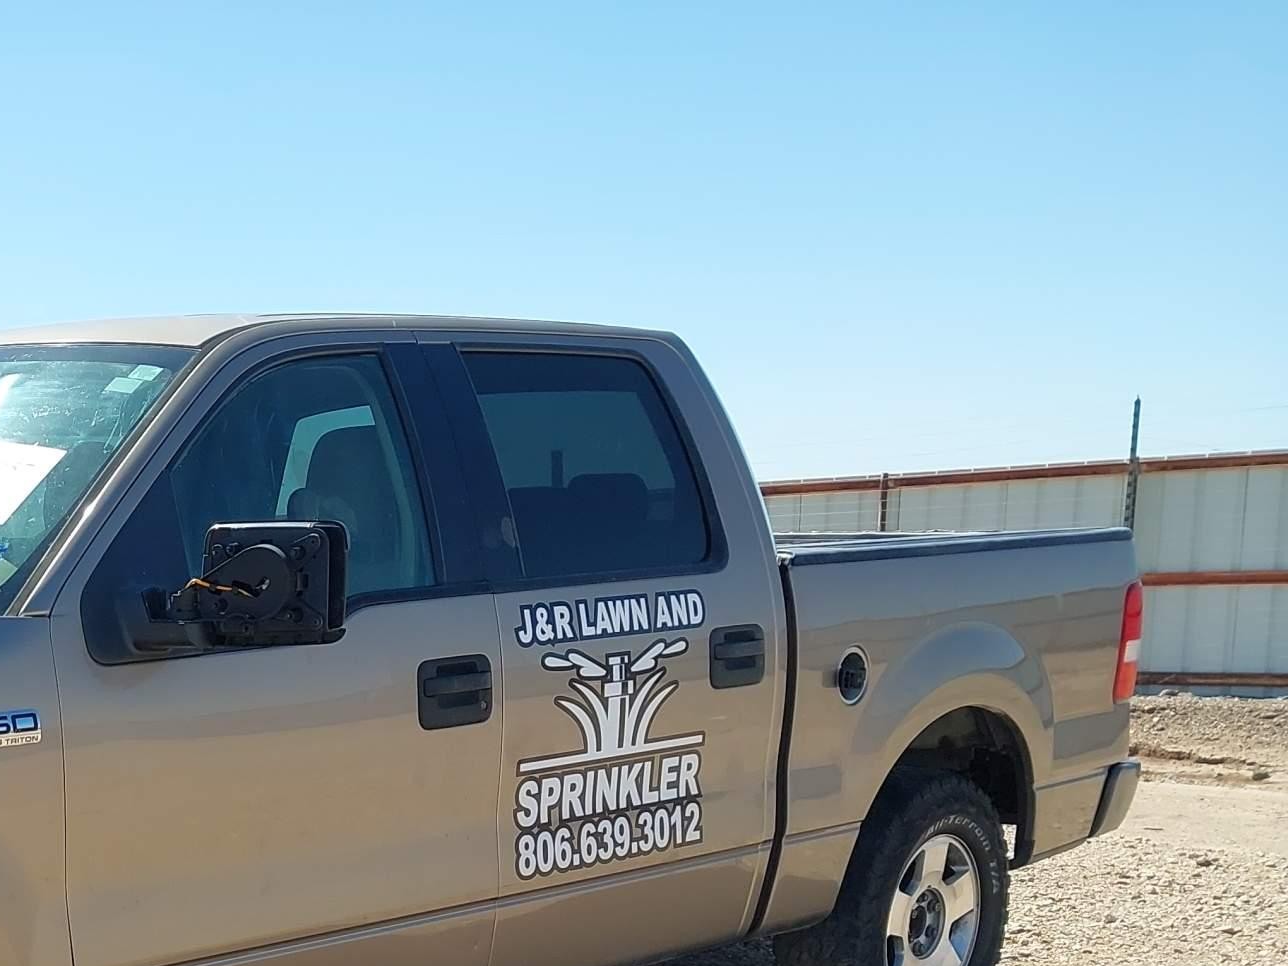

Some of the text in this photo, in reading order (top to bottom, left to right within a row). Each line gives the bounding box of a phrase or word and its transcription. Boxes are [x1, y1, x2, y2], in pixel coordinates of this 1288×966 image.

[518, 592, 704, 644] J&R LAWN AND
[5, 735, 39, 745] TRITON
[516, 752, 701, 828] SPRINKLER
[518, 802, 701, 877] 806.639.3012
